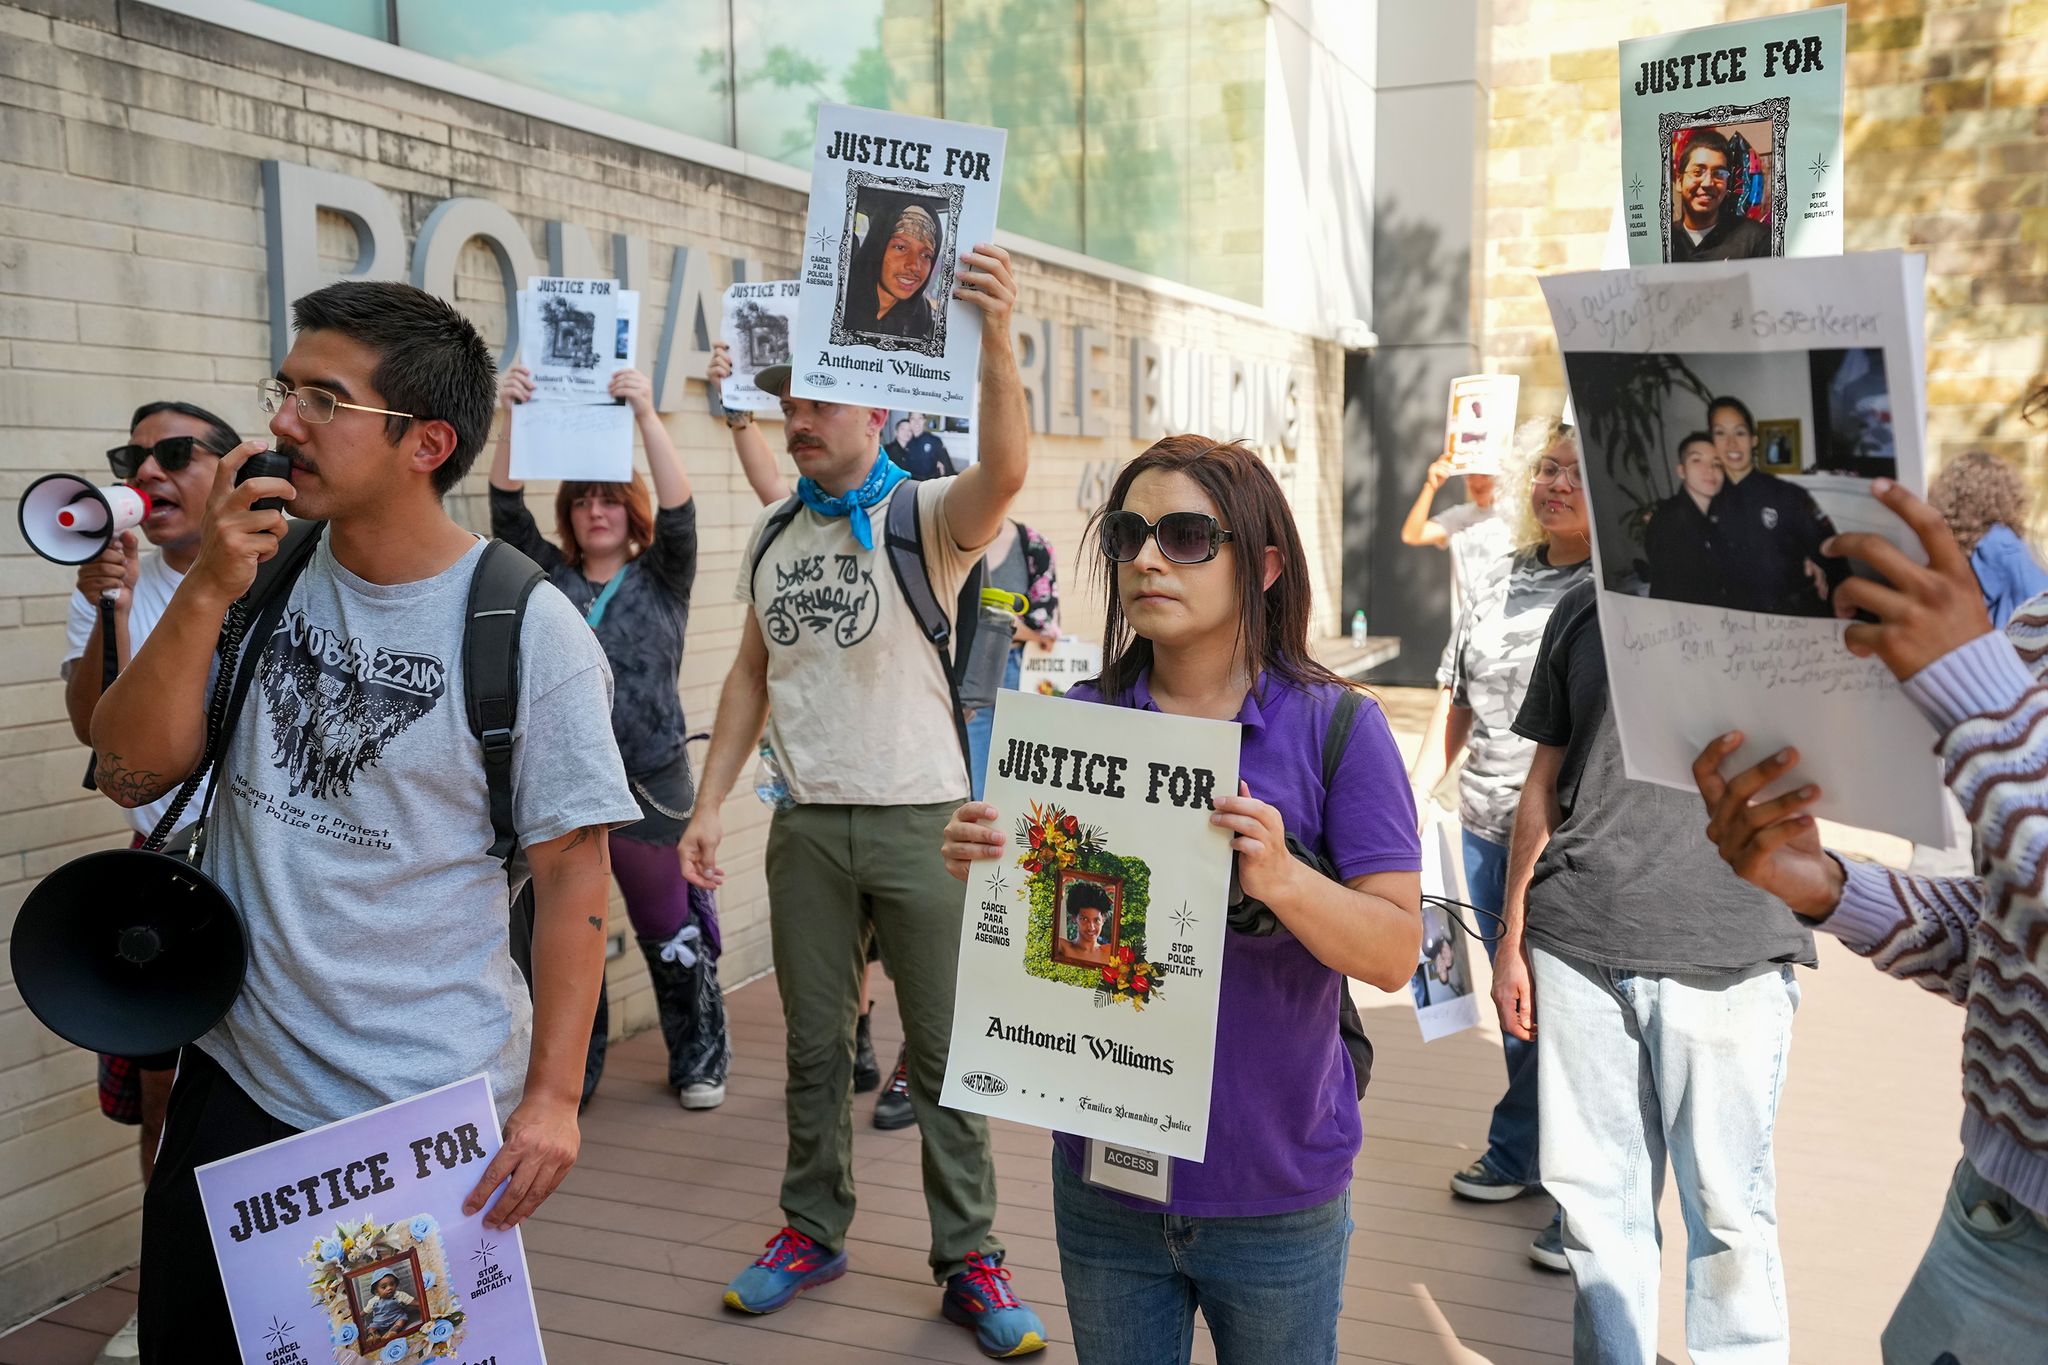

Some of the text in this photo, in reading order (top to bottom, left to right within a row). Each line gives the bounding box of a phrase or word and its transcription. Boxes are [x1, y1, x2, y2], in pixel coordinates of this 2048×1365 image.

[1635, 36, 1824, 96] JUSTICE FOR
[826, 130, 991, 182] JUSTICE FOR
[1811, 191, 1826, 199] STOP
[1809, 201, 1828, 209] POLICE
[1804, 210, 1834, 219] BRUTALITY
[812, 263, 828, 271] PARA
[537, 278, 611, 295] JUSTICE FOR
[731, 283, 775, 298] JUSTICE
[806, 278, 834, 287] ASESINOS
[817, 350, 951, 382] Anthoneil Williams
[833, 553, 859, 585] TO
[1025, 657, 1064, 672] JUSTICE
[998, 738, 1217, 811] JUSTICE FOR
[279, 800, 306, 818] Day
[311, 812, 328, 823] of
[332, 817, 390, 838] Protest
[265, 804, 311, 830] Police
[316, 823, 392, 851] Brutality
[983, 912, 1003, 925] PARA
[977, 921, 1009, 936] POLICIAS
[975, 932, 1010, 947] ASESINOS
[1171, 942, 1193, 954] STOP
[1167, 953, 1196, 966] POLICE
[1160, 962, 1204, 978] BRUTALITY
[985, 1016, 1175, 1076] Anthoneil Williams
[1078, 1096, 1192, 1133] Families Demanding Justice
[1107, 1151, 1154, 1172] ACCESS
[229, 1122, 487, 1242] JUSTICE FOR
[478, 1263, 499, 1279] STOP
[470, 1274, 513, 1300] BRUTALITY
[476, 1270, 504, 1289] POLICE
